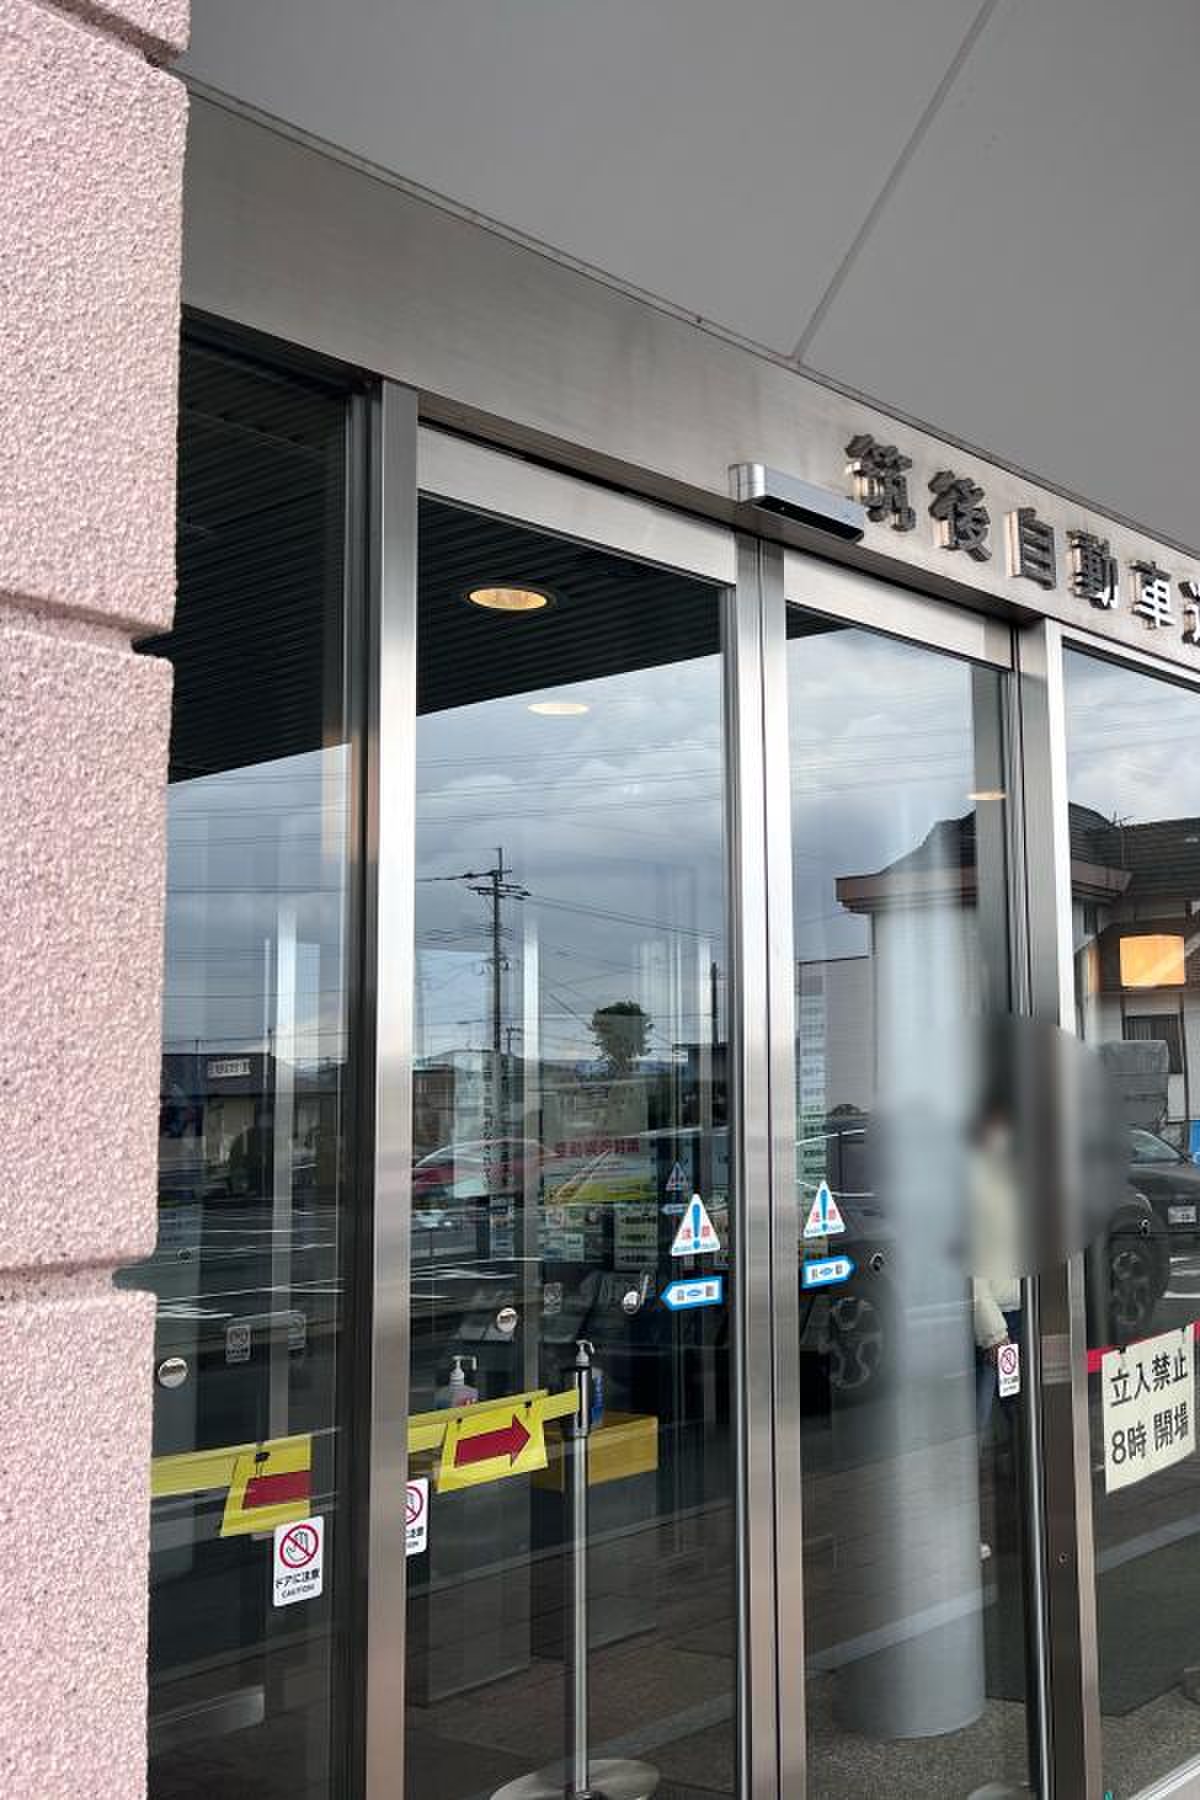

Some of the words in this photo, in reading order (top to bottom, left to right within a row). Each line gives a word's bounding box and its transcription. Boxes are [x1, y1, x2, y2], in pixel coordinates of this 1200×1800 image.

[1110, 1348, 1188, 1408] 立入禁止
[1112, 1419, 1147, 1464] 8時
[1153, 1401, 1188, 1451] 開場
